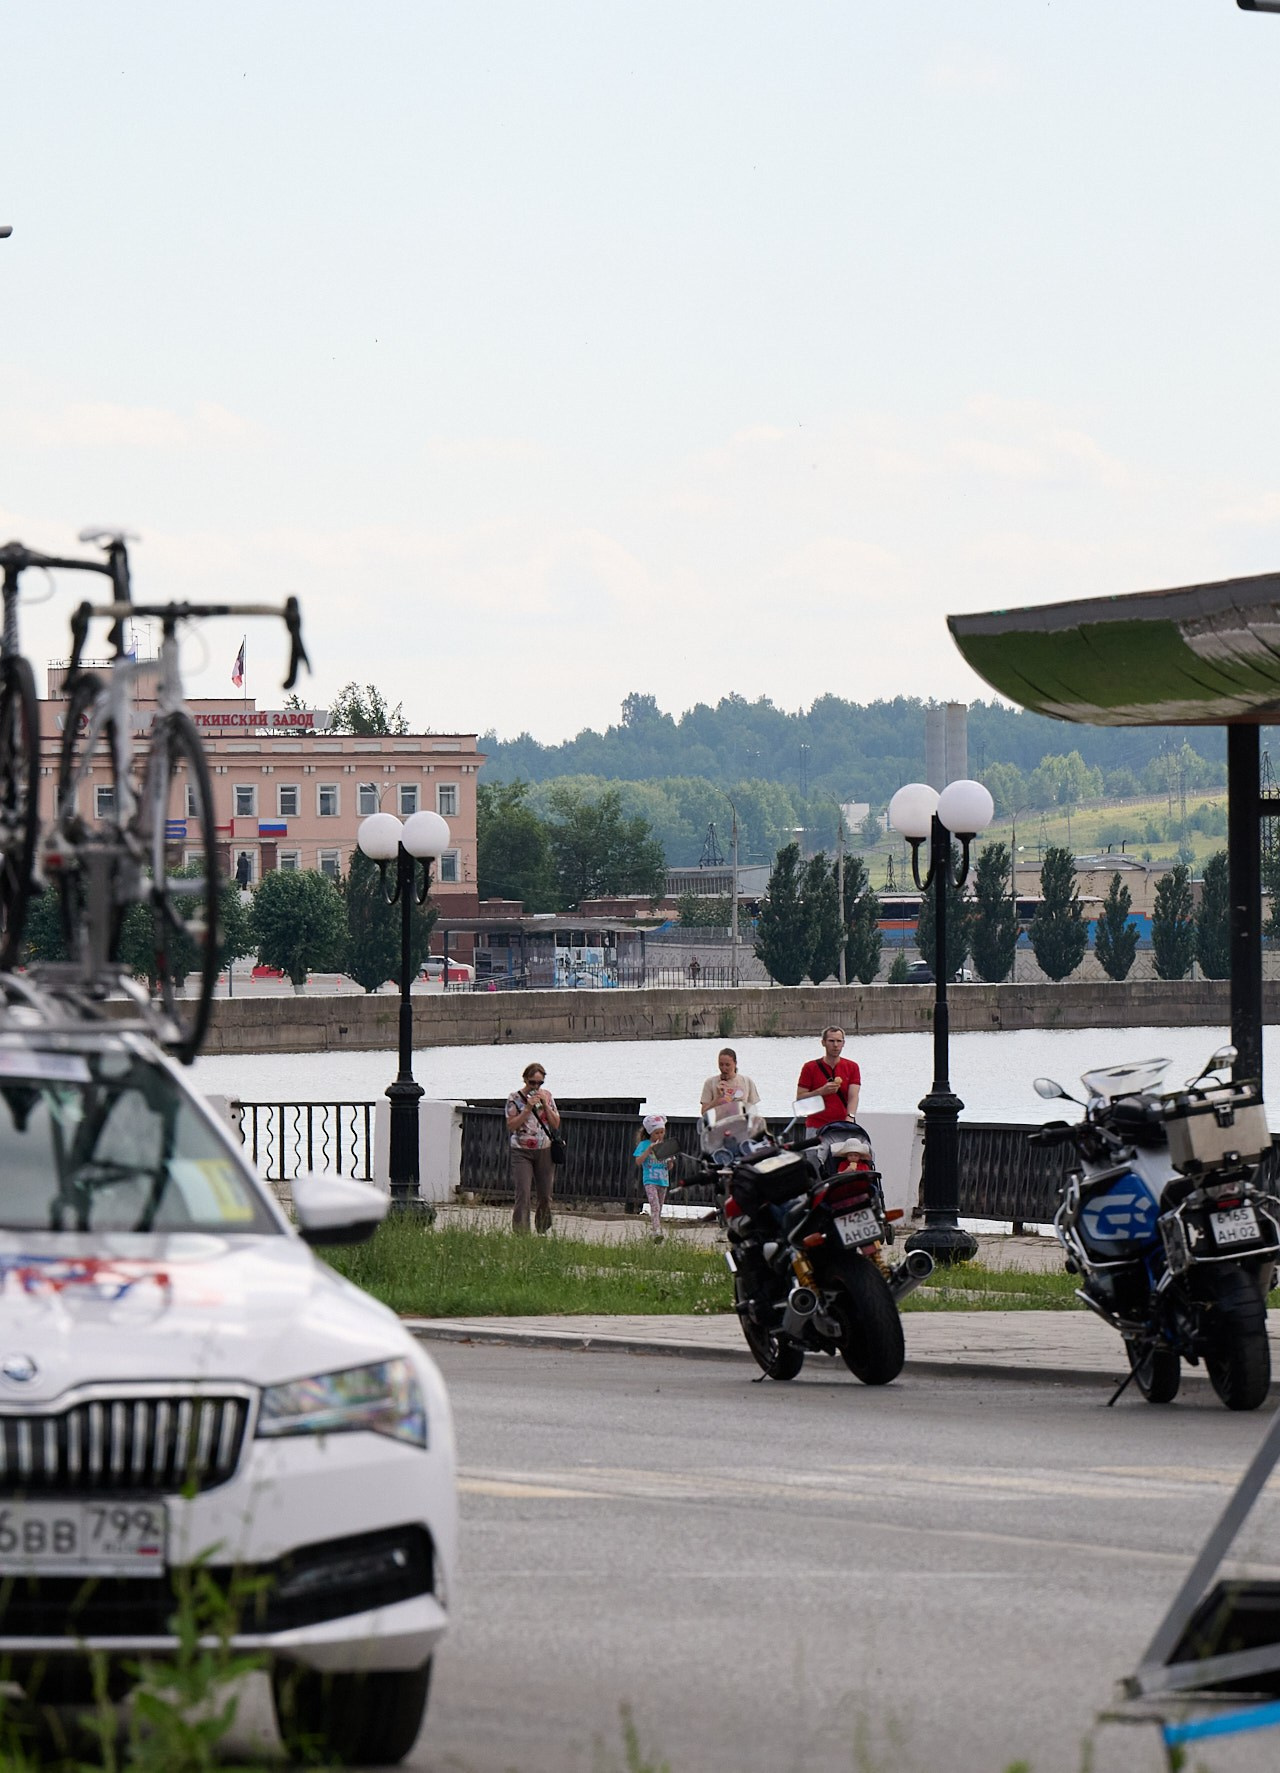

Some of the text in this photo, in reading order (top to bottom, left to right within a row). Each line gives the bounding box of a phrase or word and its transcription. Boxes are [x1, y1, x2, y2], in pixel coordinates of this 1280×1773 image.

[193, 710, 314, 728] ТКИНСКИЙ ЗАВОД
[839, 1210, 869, 1227] 7420
[862, 1225, 879, 1237] 02
[1240, 1225, 1256, 1237] 02
